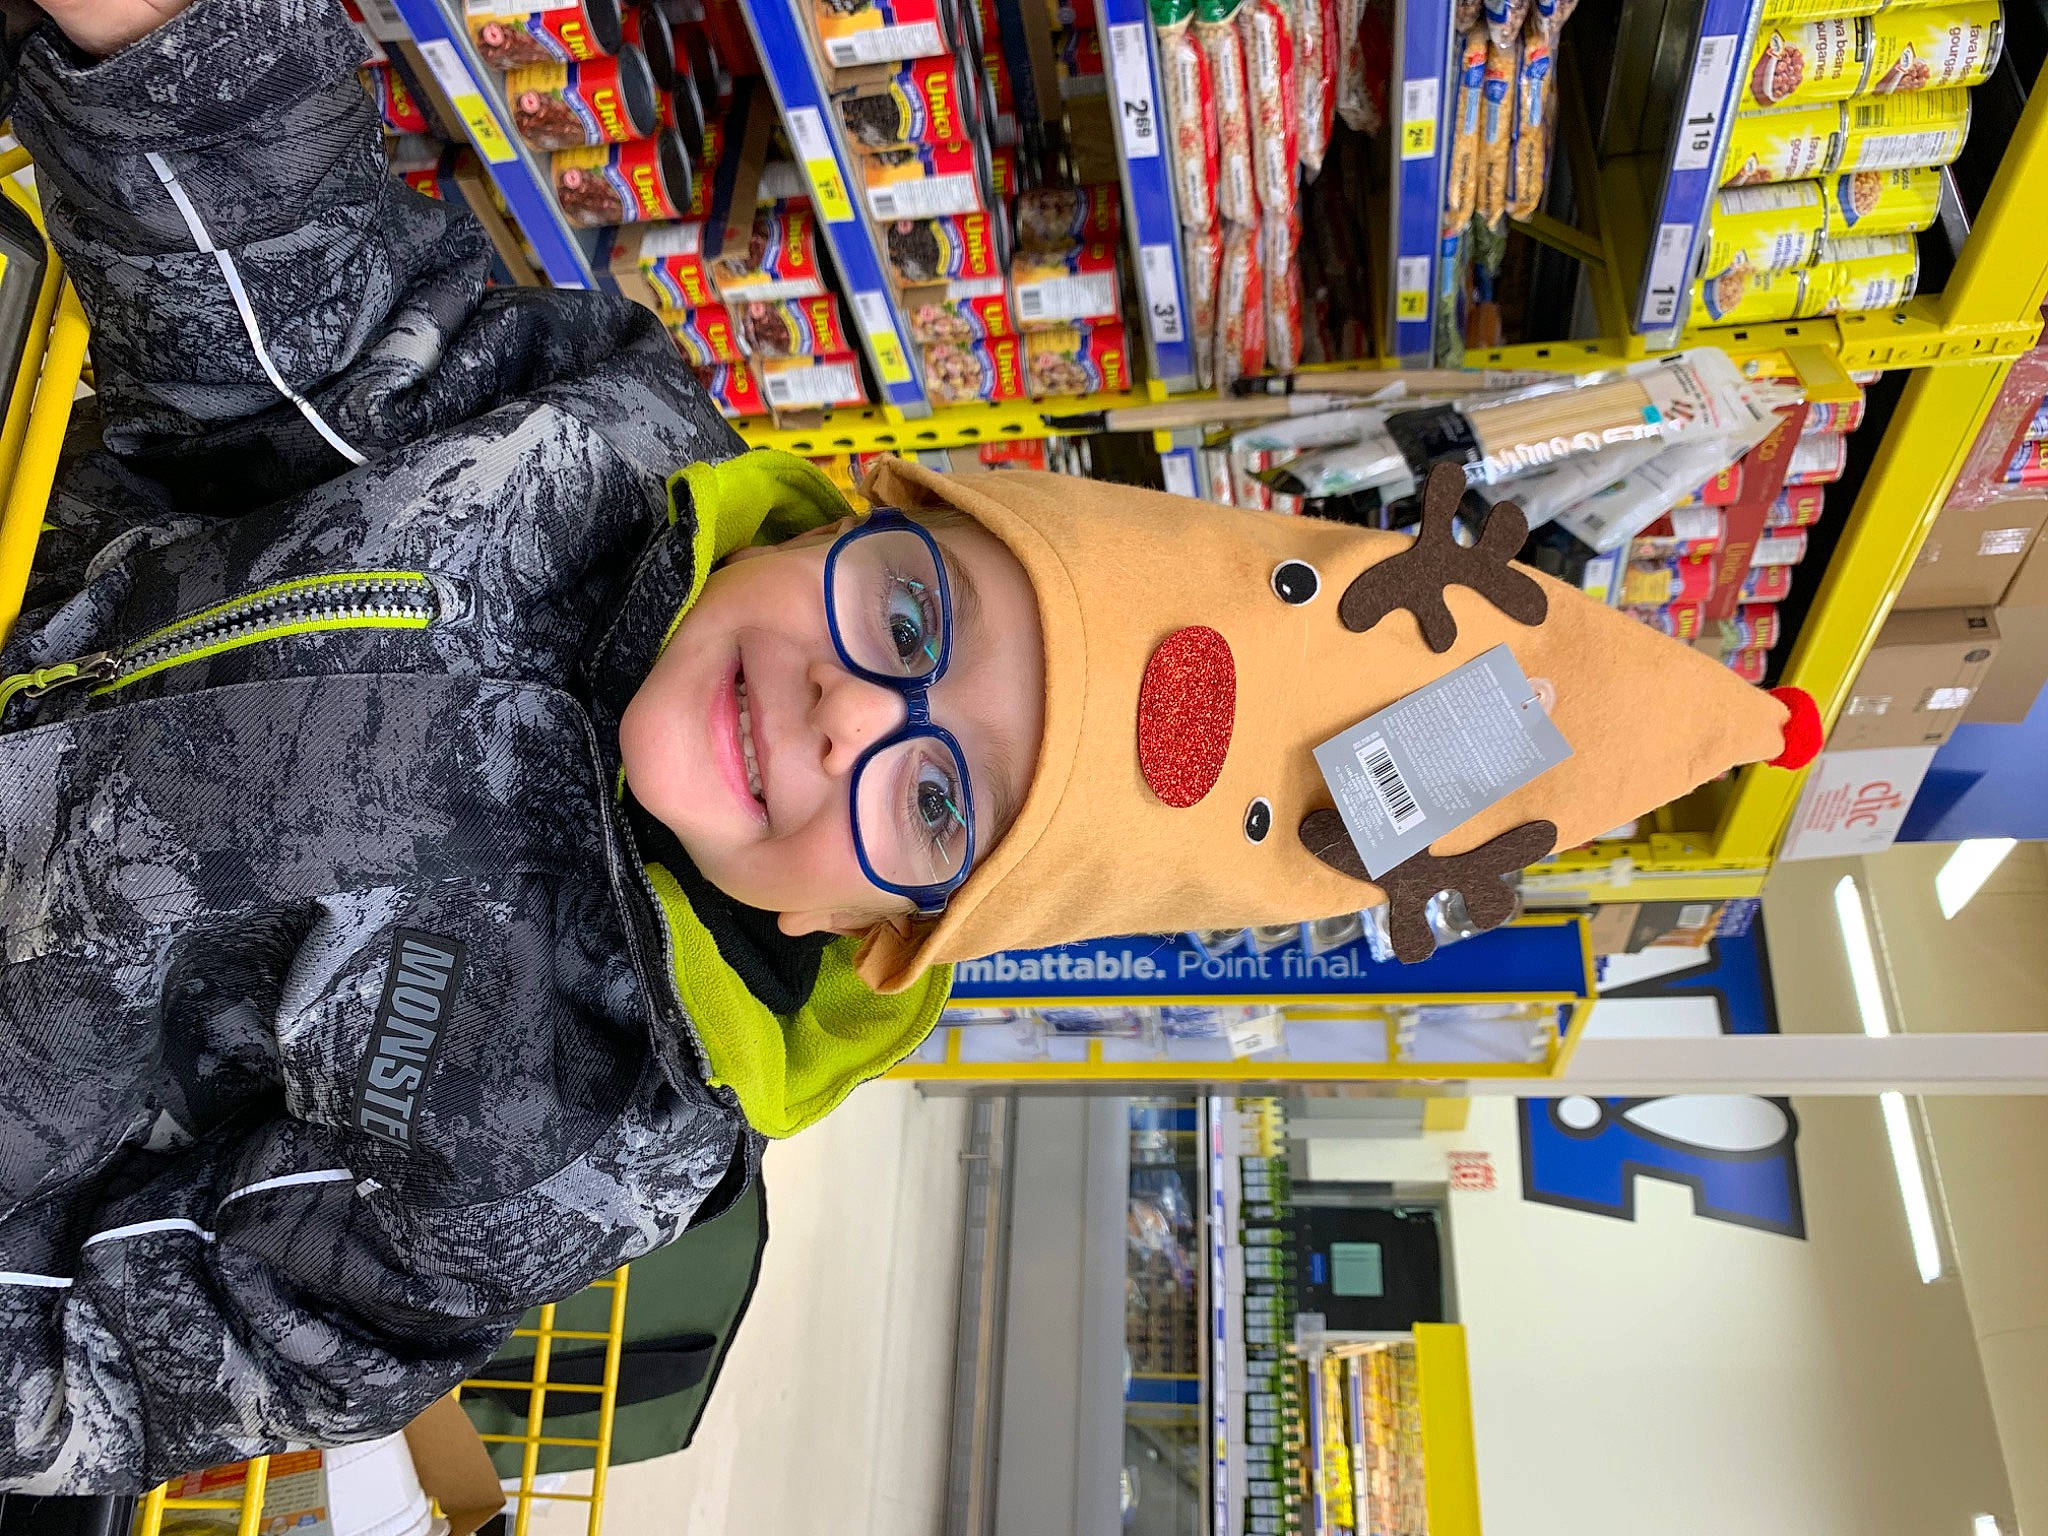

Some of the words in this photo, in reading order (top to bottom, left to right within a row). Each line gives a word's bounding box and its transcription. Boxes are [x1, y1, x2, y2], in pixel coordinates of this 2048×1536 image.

[1831, 40, 1849, 79] beans
[1968, 24, 1982, 53] fava
[924, 71, 953, 139] Unico
[1807, 136, 1822, 161] fava
[964, 214, 988, 274] Unico
[994, 341, 1017, 395] Unico
[1845, 781, 1904, 829] clic
[1177, 950, 1272, 980] Point
[1280, 948, 1368, 980] final.
